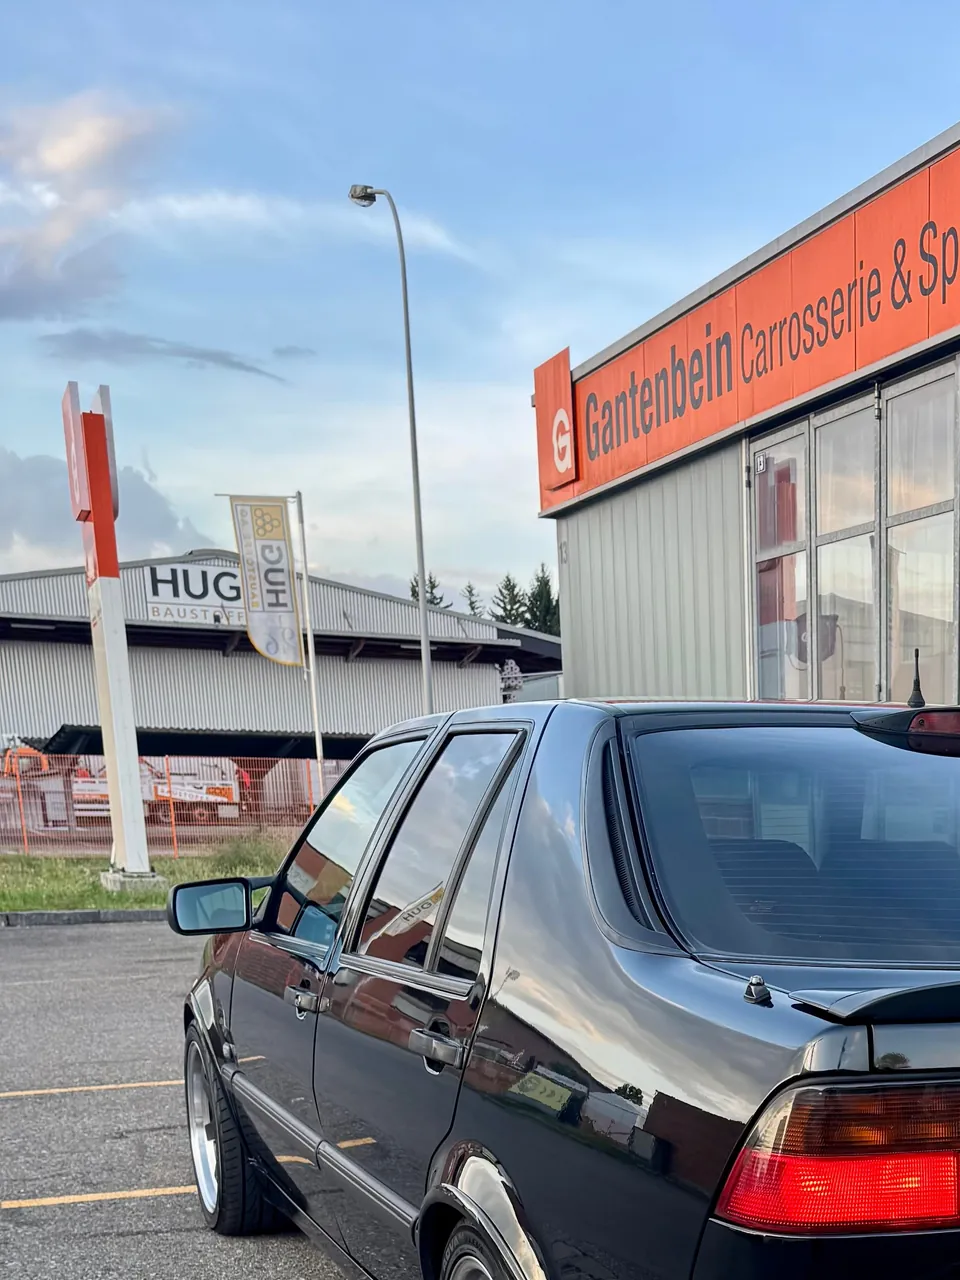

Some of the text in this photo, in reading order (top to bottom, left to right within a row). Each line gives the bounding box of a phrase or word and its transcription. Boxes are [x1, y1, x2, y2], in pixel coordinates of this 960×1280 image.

[584, 323, 734, 462] Gantenbein
[740, 260, 882, 385] Carrosserie
[890, 238, 914, 310] &
[150, 566, 242, 602] HUG
[402, 901, 433, 922] HUG
